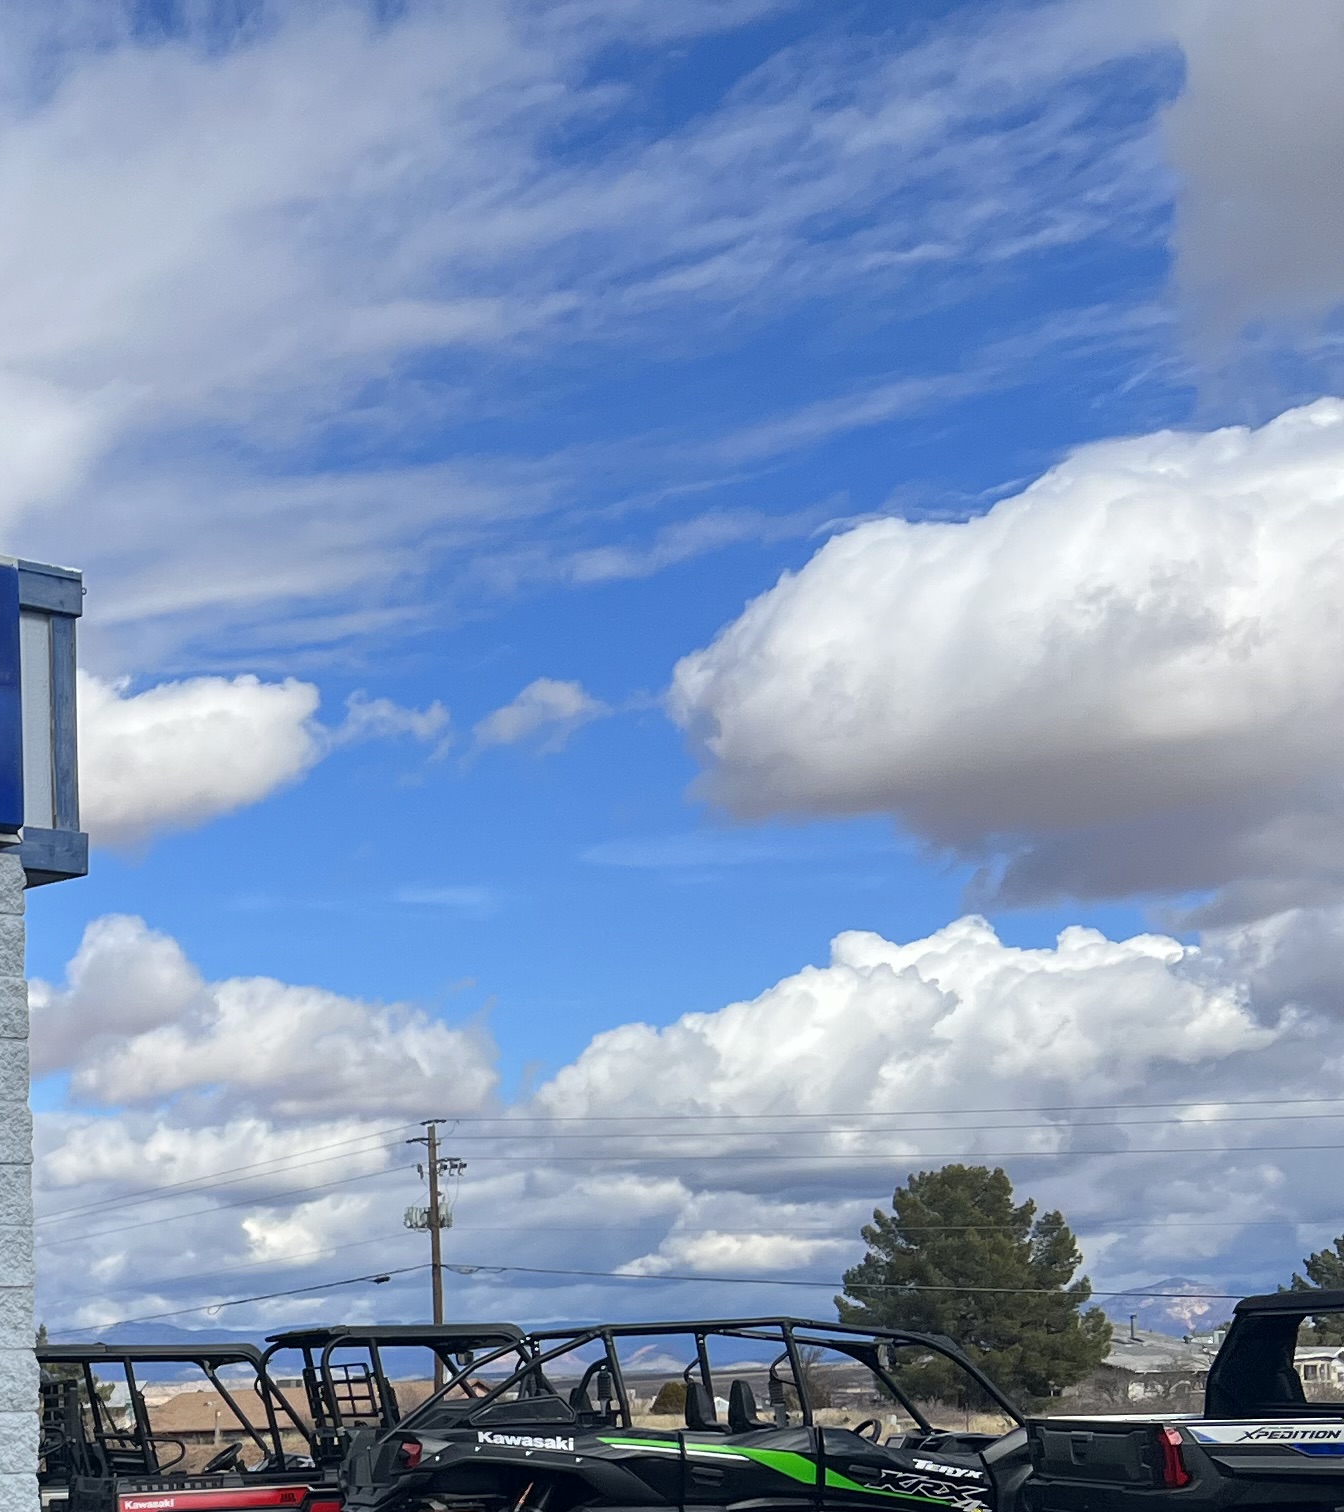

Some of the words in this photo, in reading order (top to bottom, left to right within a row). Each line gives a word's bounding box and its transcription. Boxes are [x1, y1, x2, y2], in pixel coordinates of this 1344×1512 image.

[477, 1430, 575, 1451] Kawasaki
[1235, 1426, 1342, 1442] XPEDITION
[124, 1498, 175, 1511] Kawasaki
